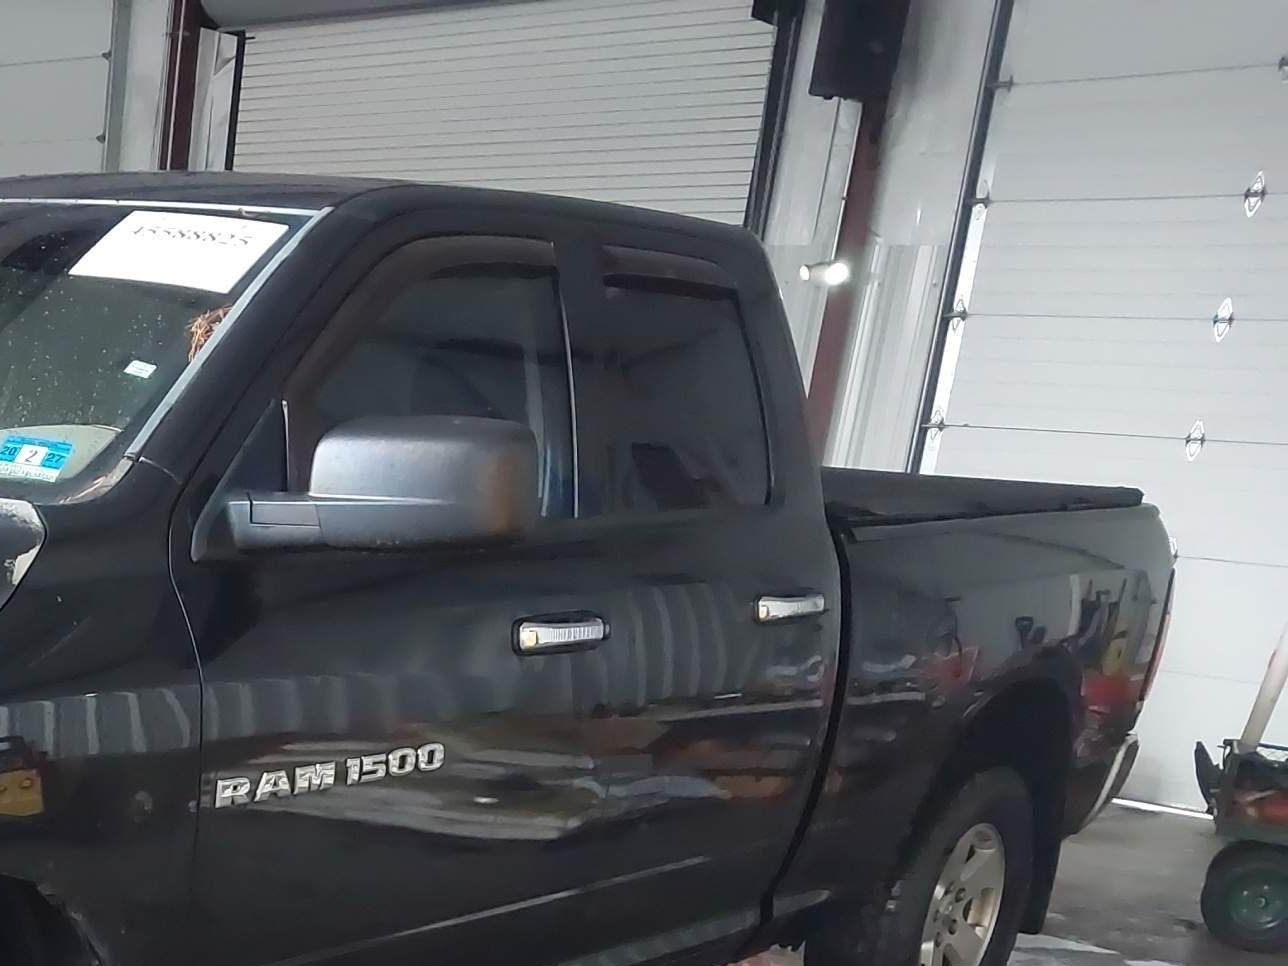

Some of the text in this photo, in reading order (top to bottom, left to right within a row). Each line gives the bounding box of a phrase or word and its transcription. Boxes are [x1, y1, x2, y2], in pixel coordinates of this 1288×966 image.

[24, 449, 38, 463] 2
[215, 742, 445, 809] RAM 1500
